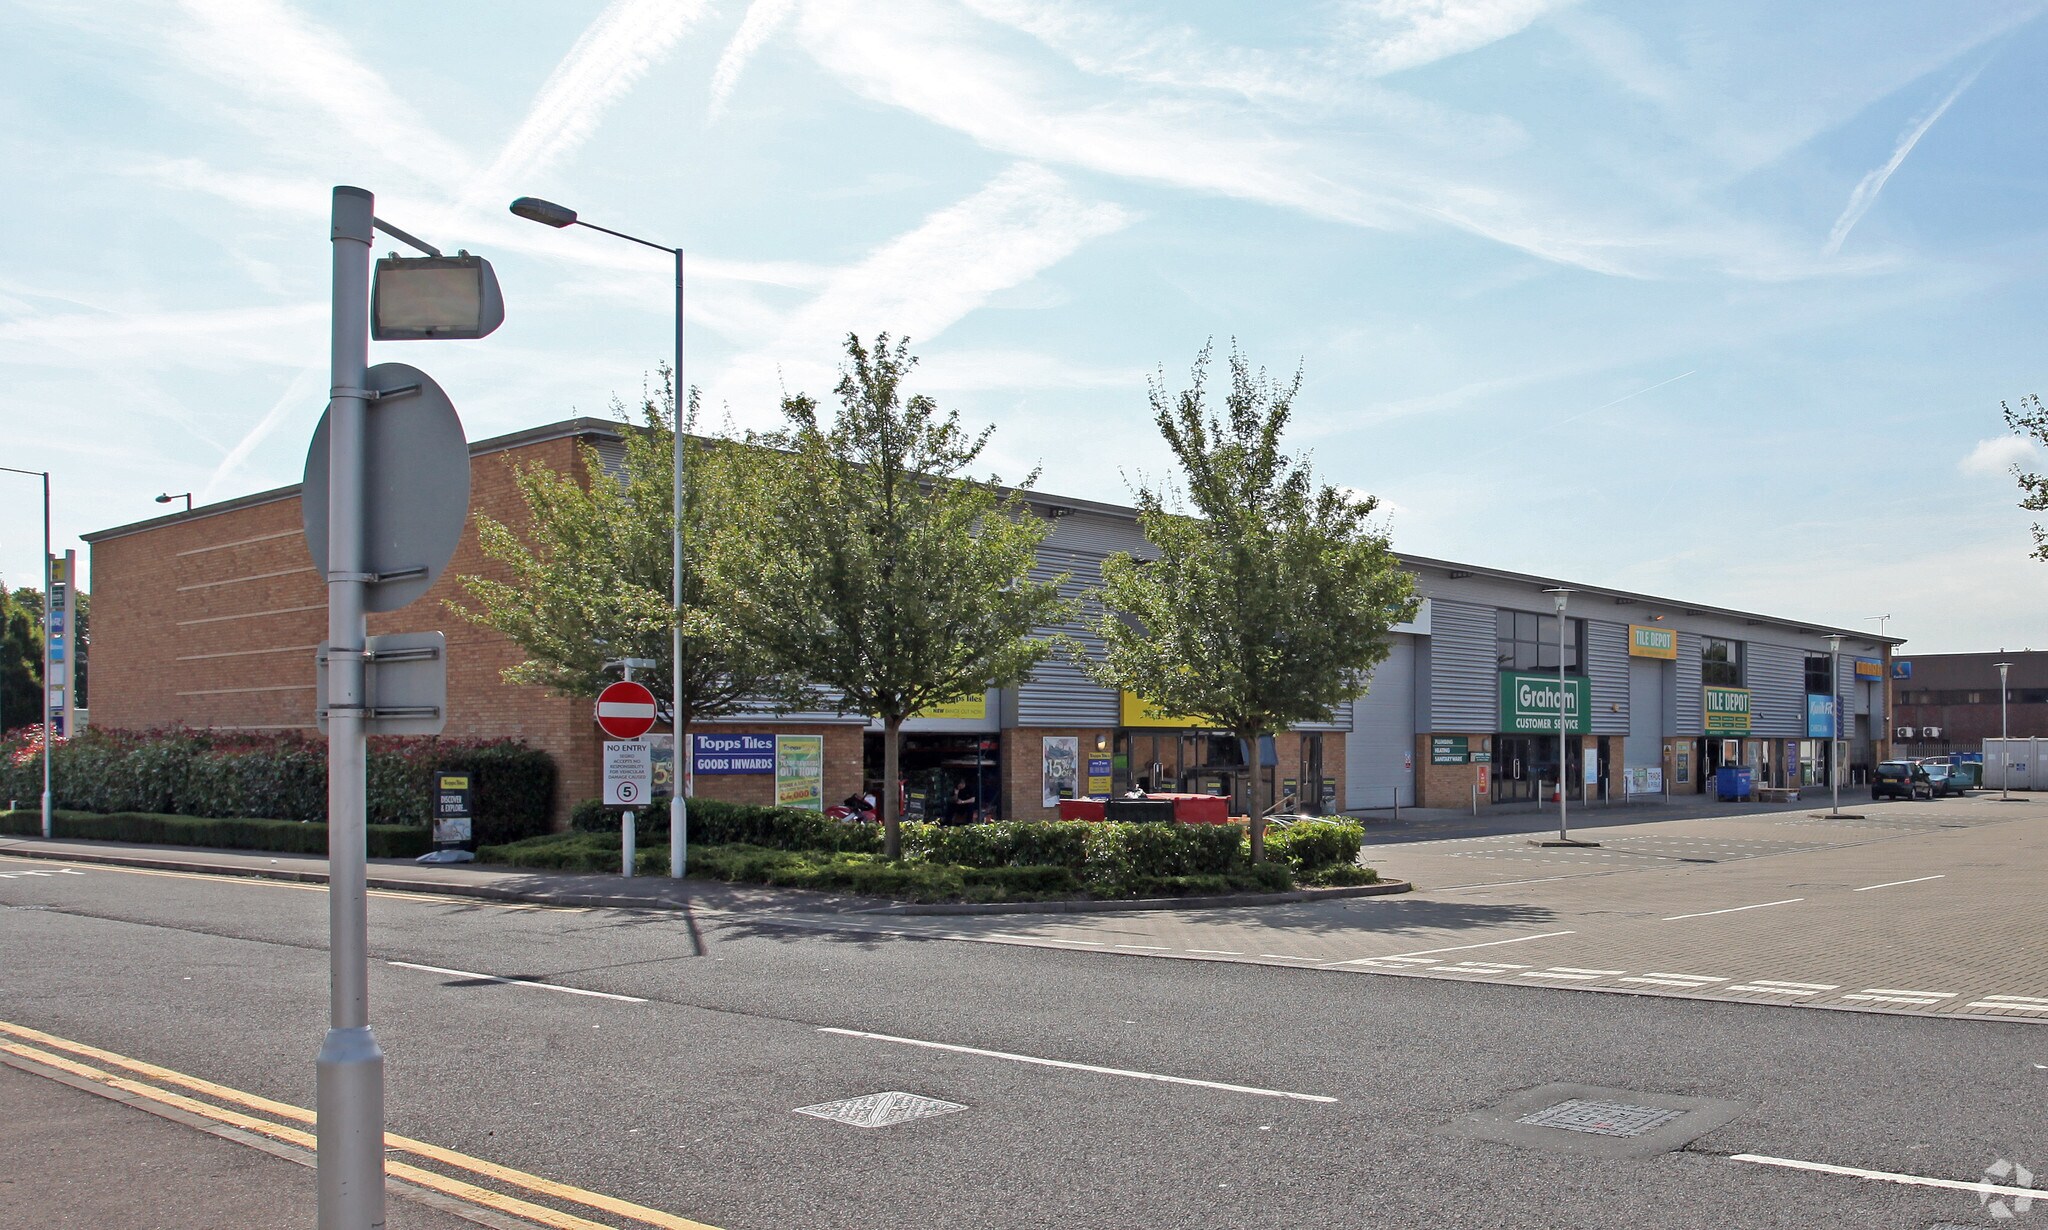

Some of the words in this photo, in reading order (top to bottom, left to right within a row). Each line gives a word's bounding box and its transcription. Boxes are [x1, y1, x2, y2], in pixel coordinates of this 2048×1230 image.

[1636, 630, 1649, 646] TILE
[1651, 631, 1671, 648] DEPOT
[1520, 684, 1574, 708] Graham
[1707, 691, 1723, 710] TILE
[1725, 692, 1748, 711] DEPOT
[1516, 718, 1551, 729] CUSTOMER
[1554, 719, 1578, 730] SEVICE
[698, 736, 741, 751] Topps
[742, 736, 773, 749] Tiles
[698, 759, 729, 769] GOODS
[731, 759, 773, 769] INWARDS
[780, 766, 798, 776] OUT
[623, 786, 632, 797] 5
[441, 795, 462, 803] DISCOVER
